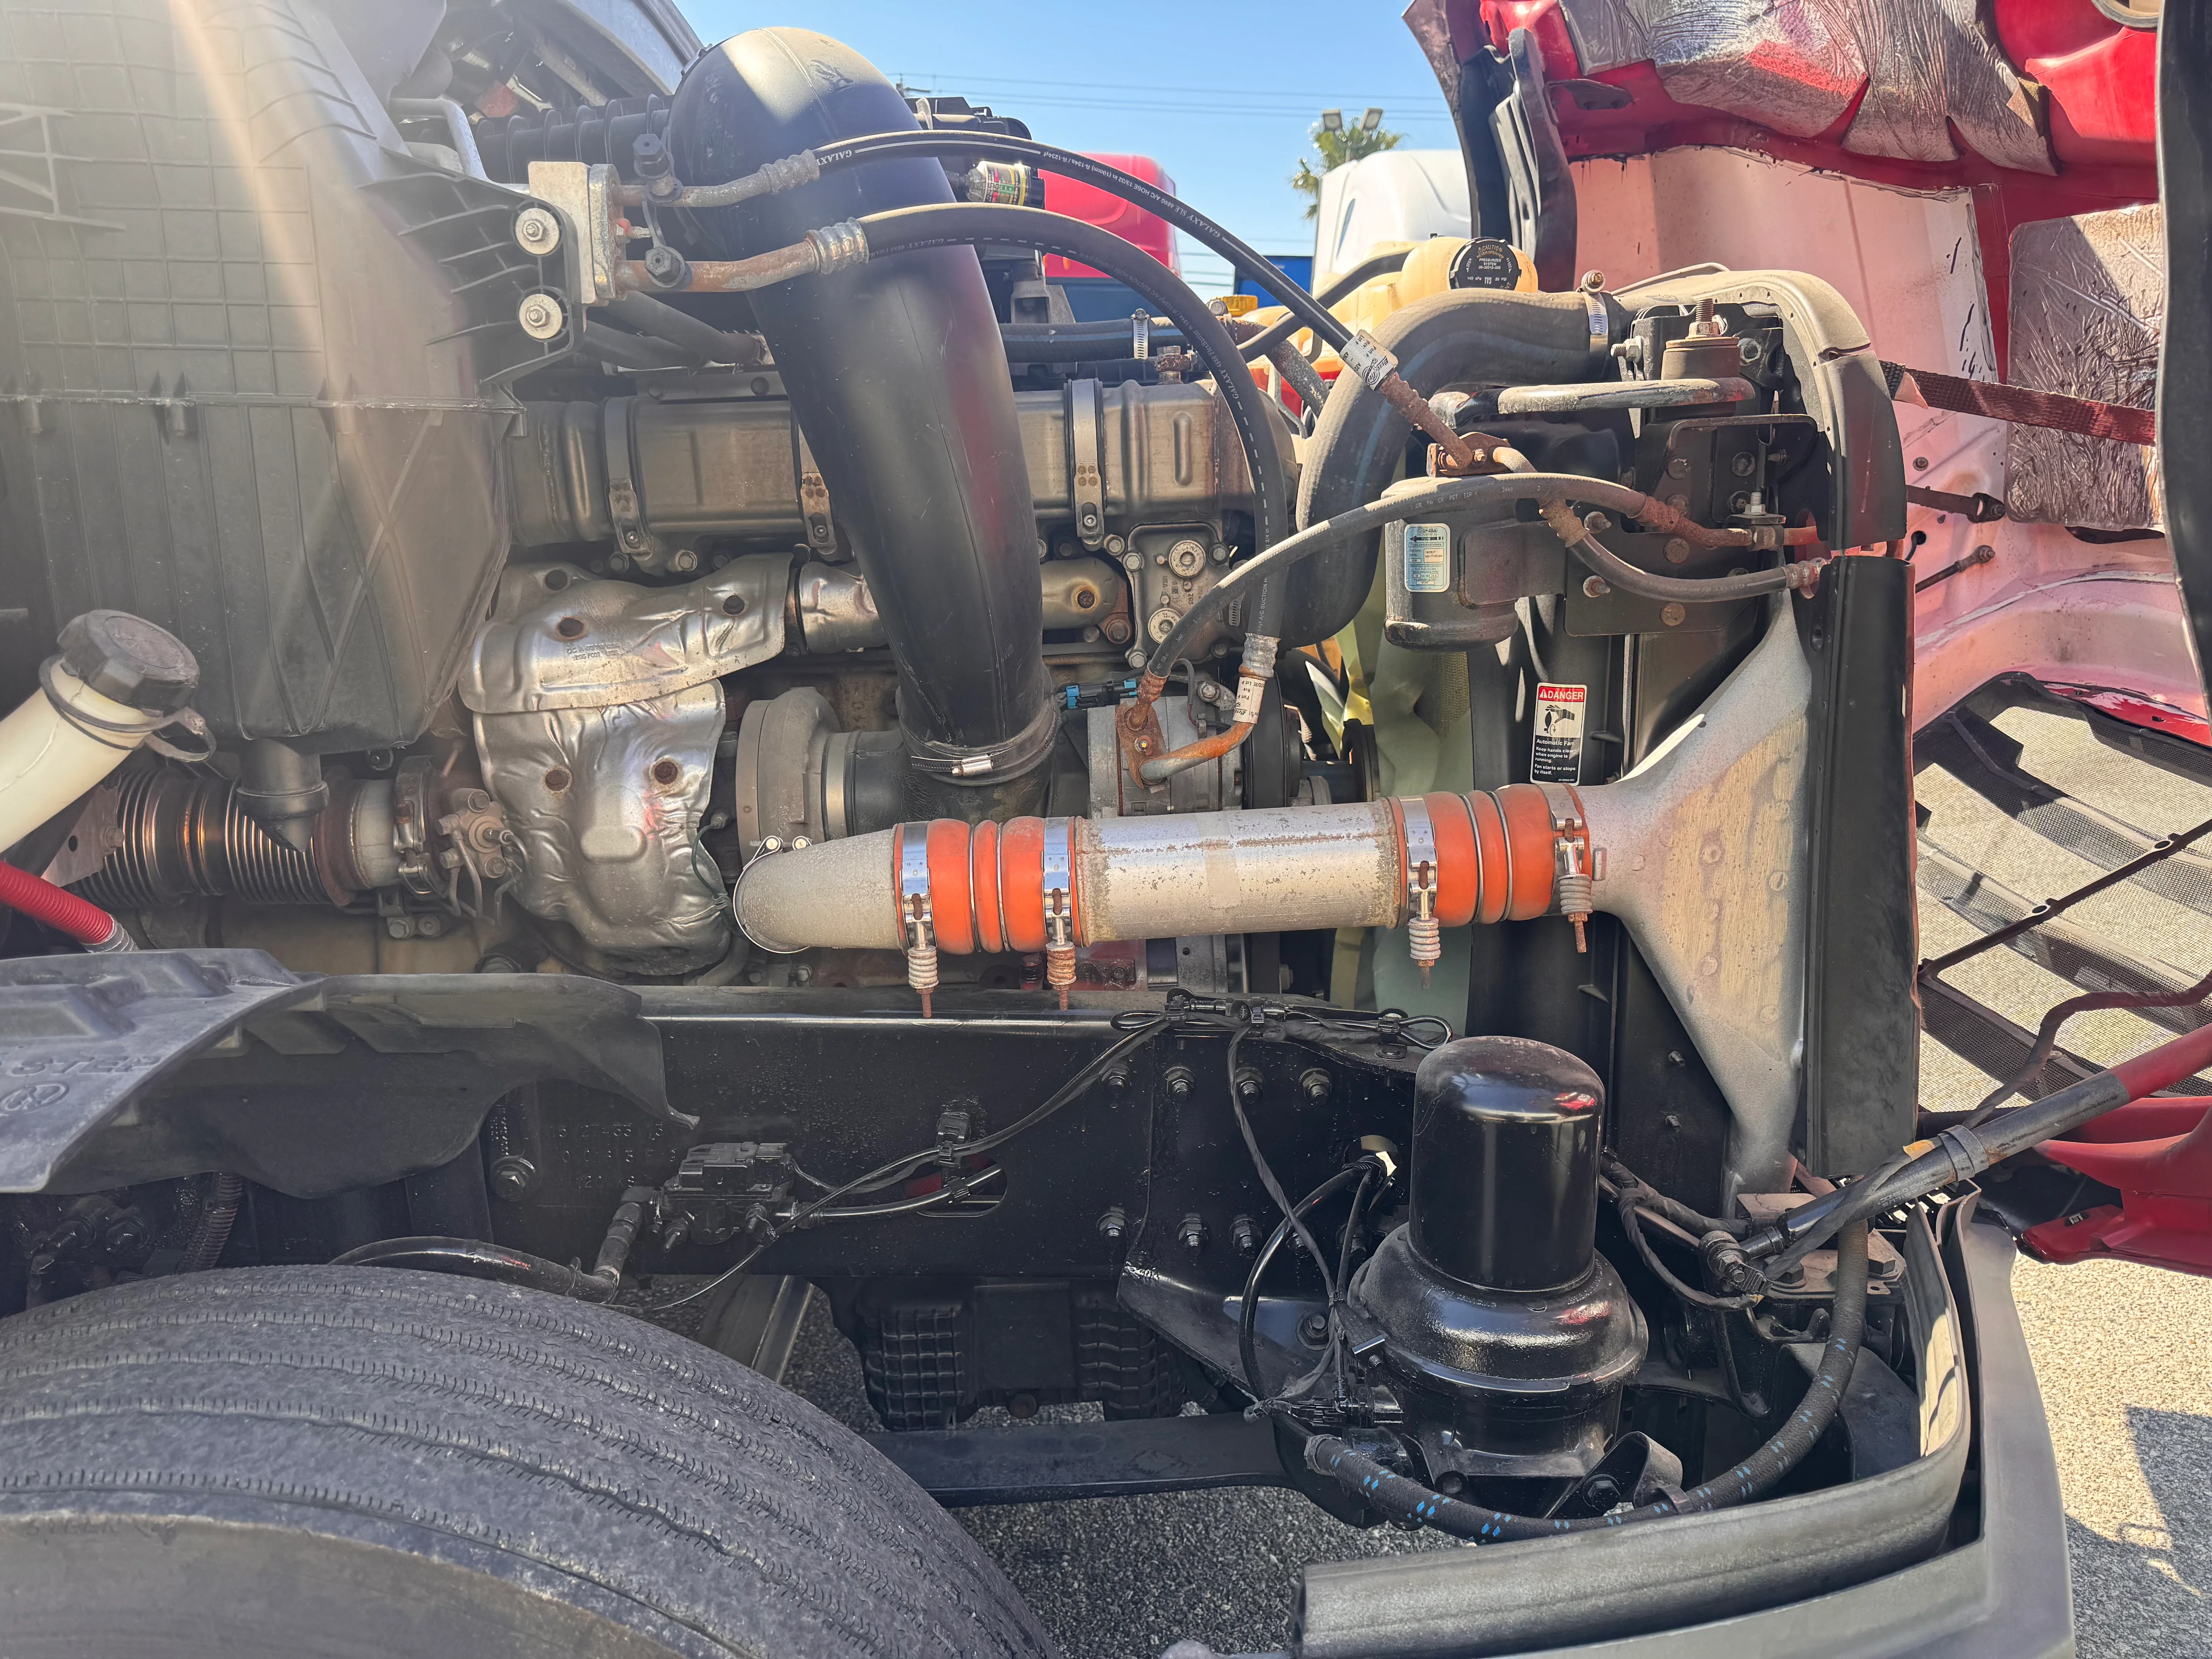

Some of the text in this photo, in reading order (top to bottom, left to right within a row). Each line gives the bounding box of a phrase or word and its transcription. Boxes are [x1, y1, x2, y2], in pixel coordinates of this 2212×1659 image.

[1043, 151, 1068, 163] R-1234yf
[1071, 159, 1091, 170] R-134a
[1091, 165, 1112, 178] (10mm)
[1118, 176, 1133, 187] 13/32
[1133, 184, 1150, 196] HOSE
[1150, 192, 1161, 201] A/C
[1175, 205, 1187, 216] SLE
[1185, 214, 1221, 237] GALAXY
[907, 238, 944, 249] GALAXY
[1193, 330, 1215, 358] FlexBarrier
[1212, 357, 1223, 368] 4880
[1219, 369, 1239, 399] GALAXY
[1449, 493, 1459, 501] PET
[1548, 691, 1583, 700] DANGER
